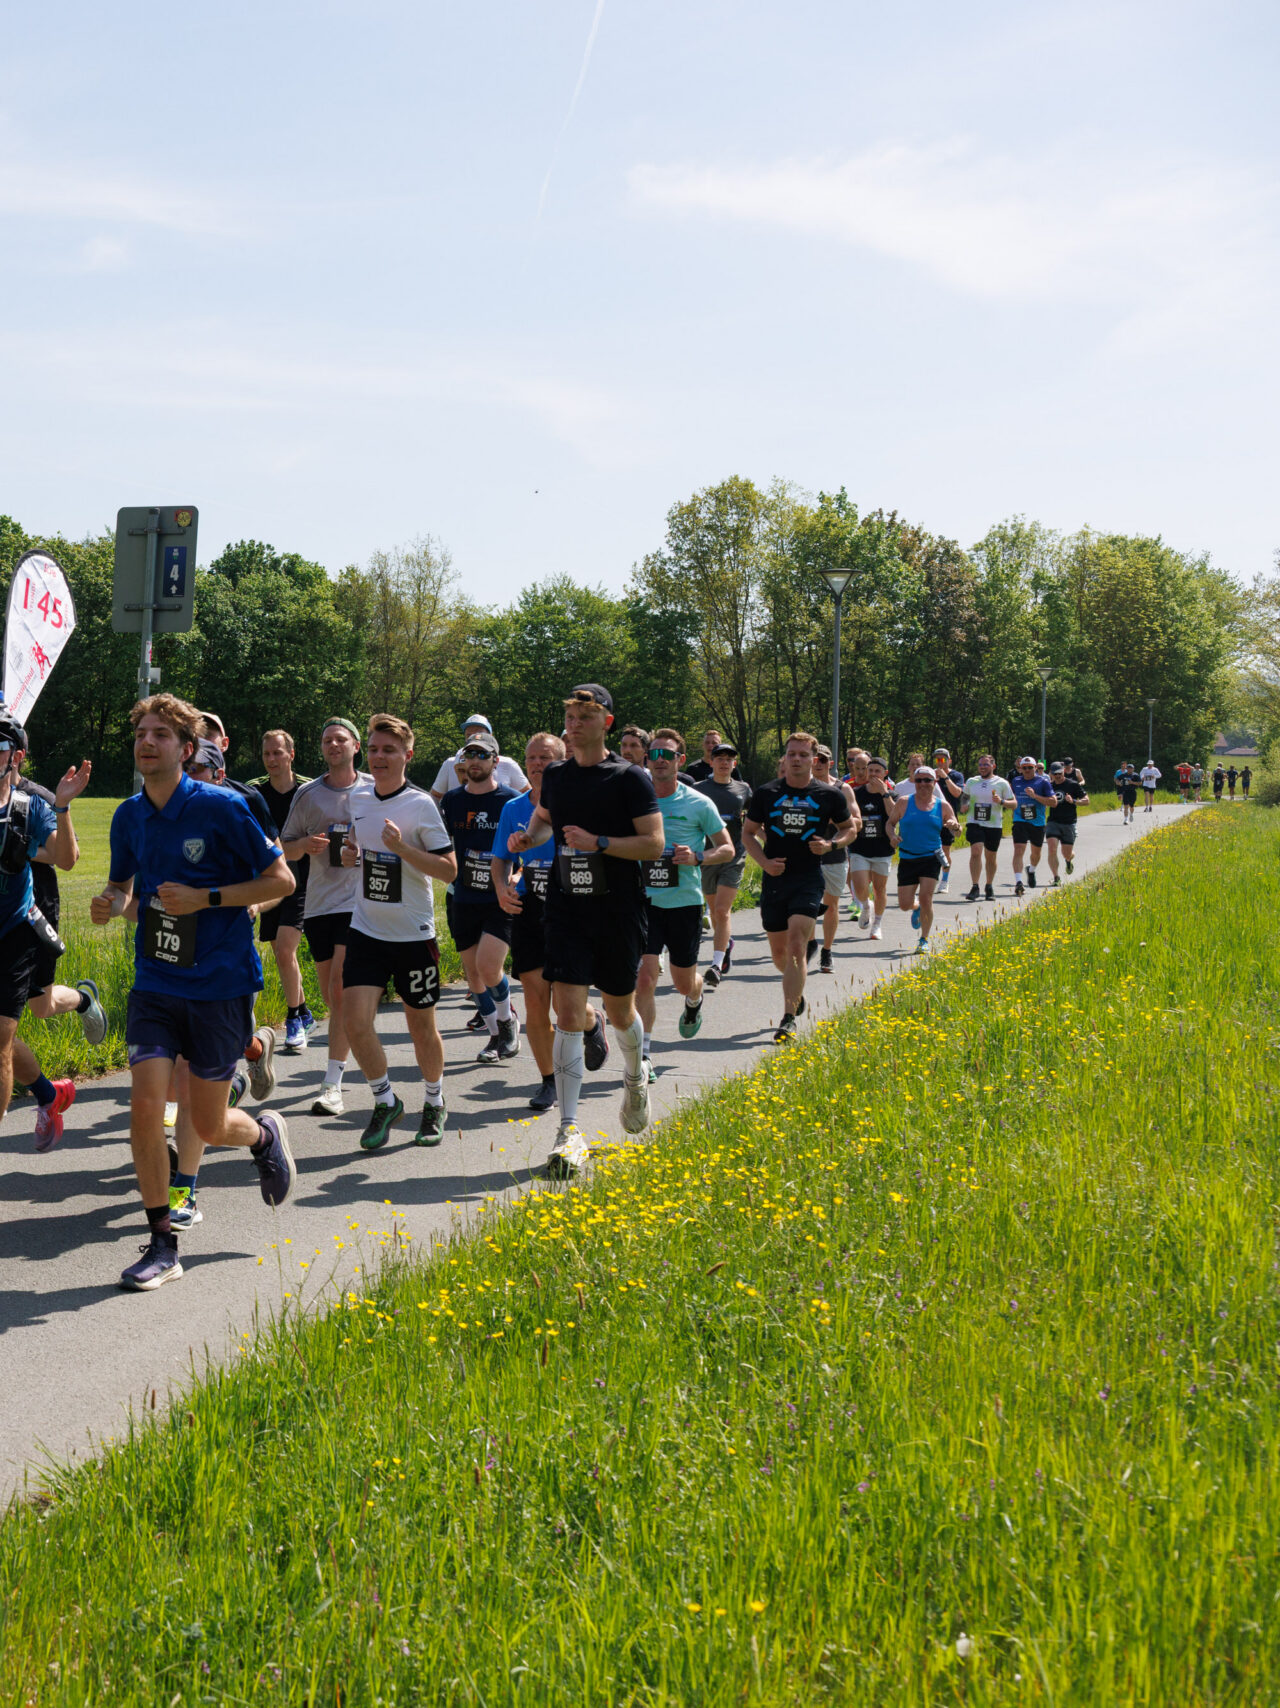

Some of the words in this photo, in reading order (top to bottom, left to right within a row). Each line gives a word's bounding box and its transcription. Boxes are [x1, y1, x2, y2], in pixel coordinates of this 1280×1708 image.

[170, 564, 179, 581] 4
[37, 591, 63, 629] 45
[783, 813, 806, 826] 955
[471, 870, 490, 882] 185
[570, 871, 593, 885] 869
[649, 868, 669, 880] 205
[368, 876, 390, 892] 357
[155, 930, 180, 952] 179
[408, 966, 438, 993] 22
